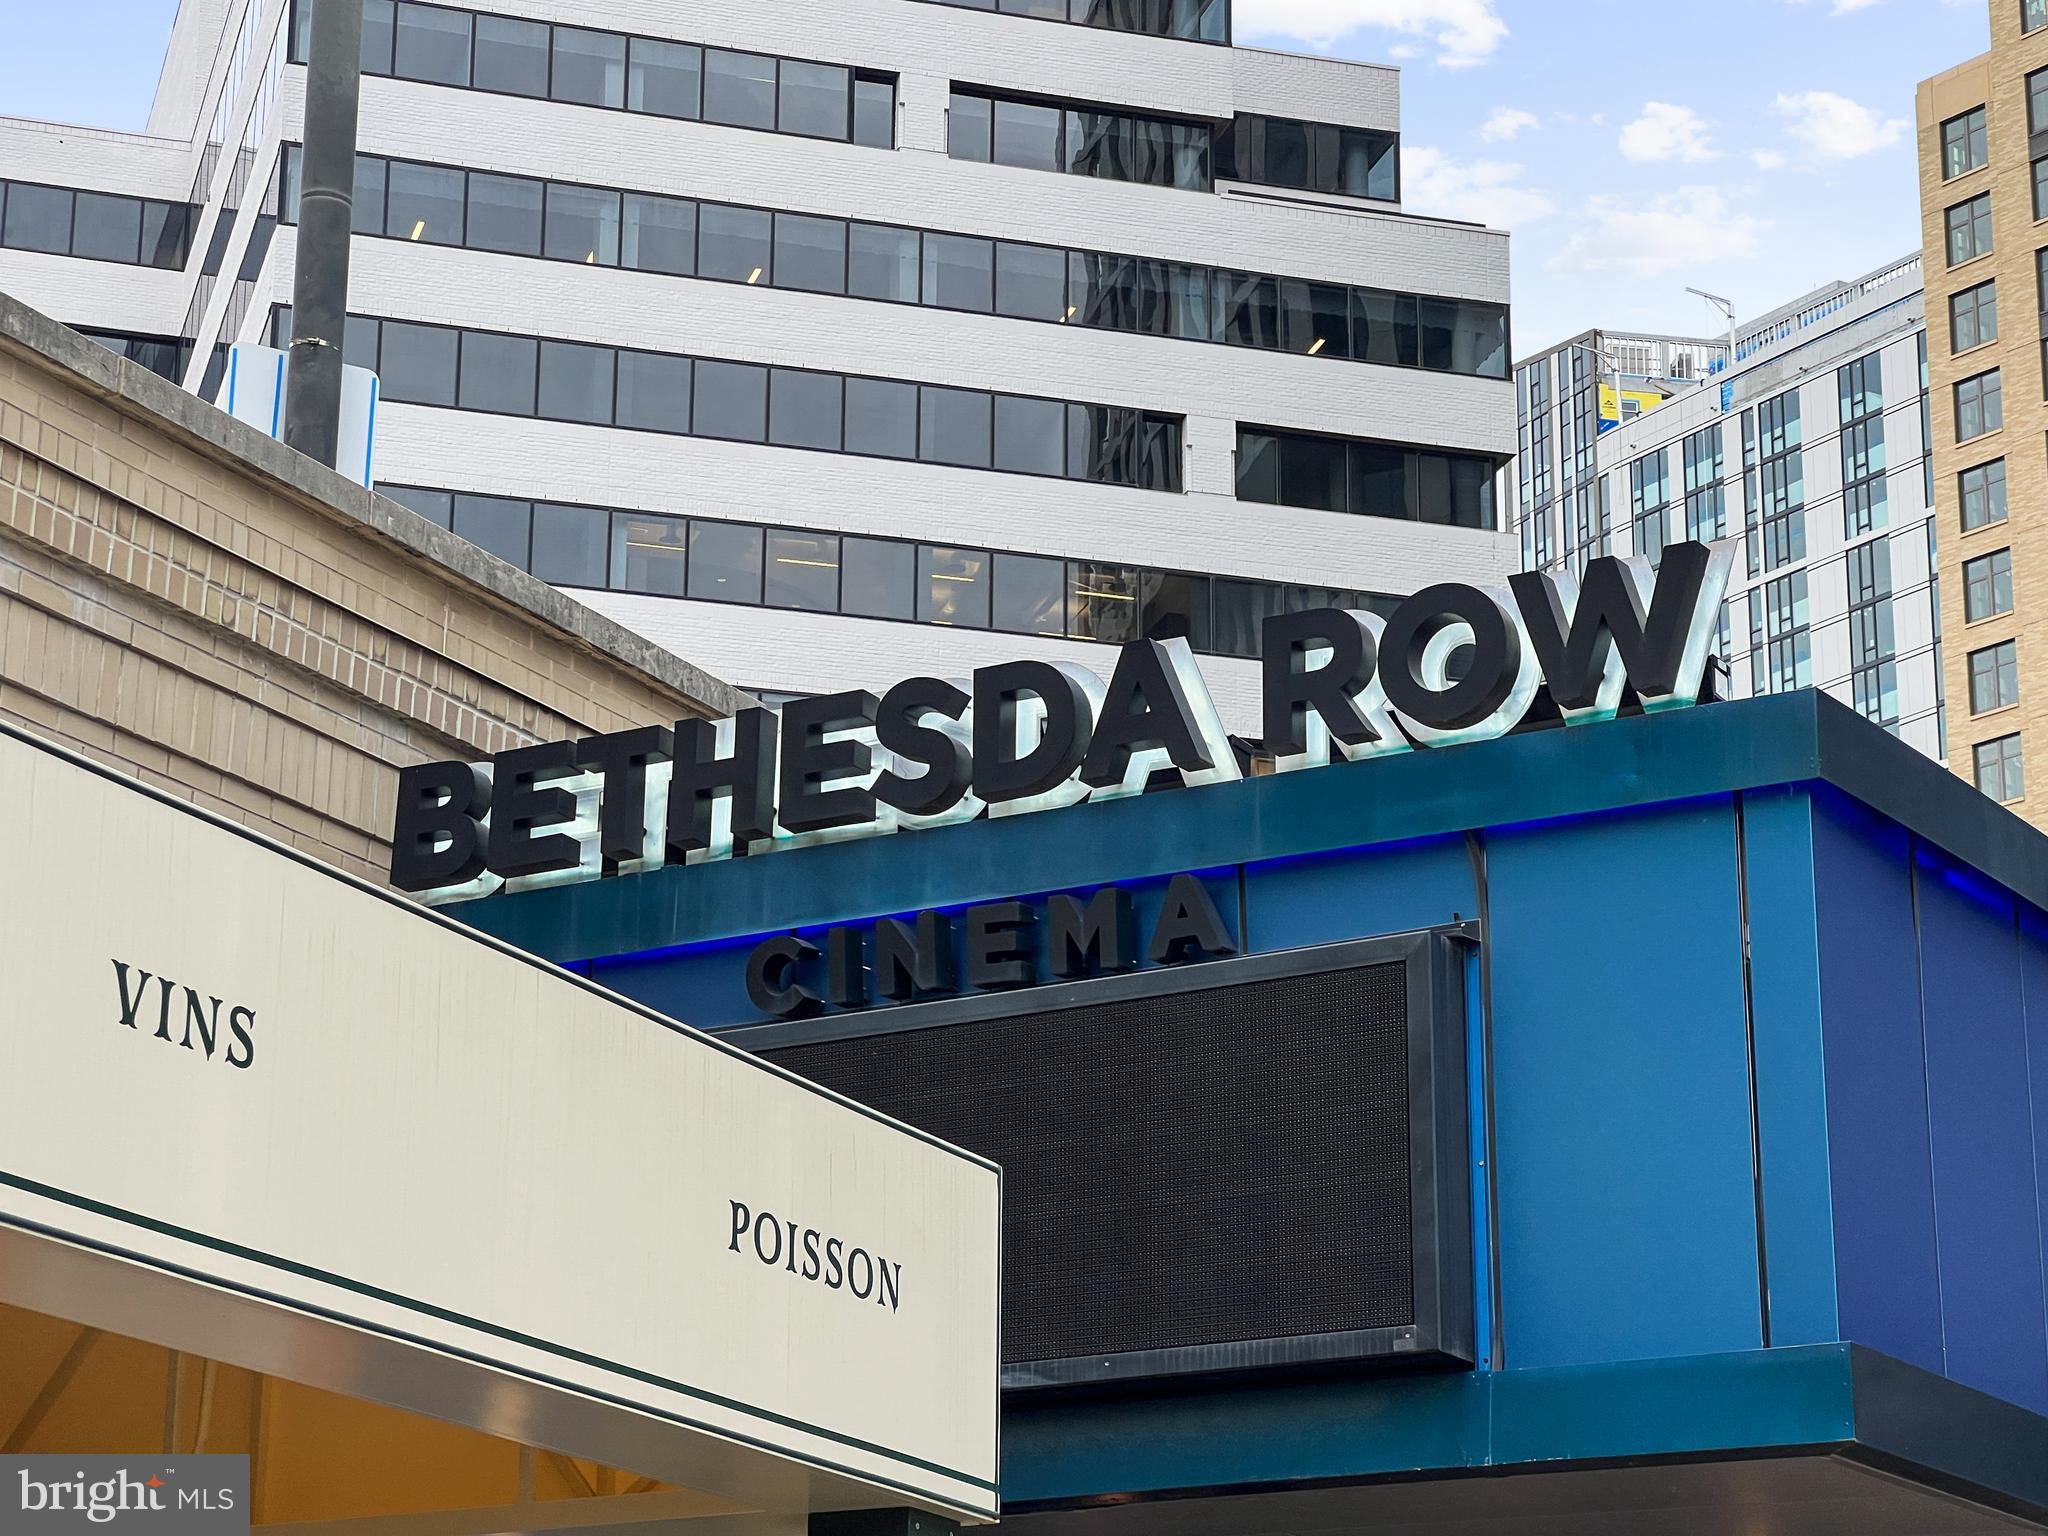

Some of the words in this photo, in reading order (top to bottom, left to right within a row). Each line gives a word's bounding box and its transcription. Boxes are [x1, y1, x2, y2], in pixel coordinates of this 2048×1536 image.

[390, 637, 1240, 902] BETHESDA
[1262, 540, 1735, 770] ROW
[747, 875, 1236, 1018] CINEMA
[111, 958, 256, 1069] VINS
[728, 1199, 901, 1314] POISSON
